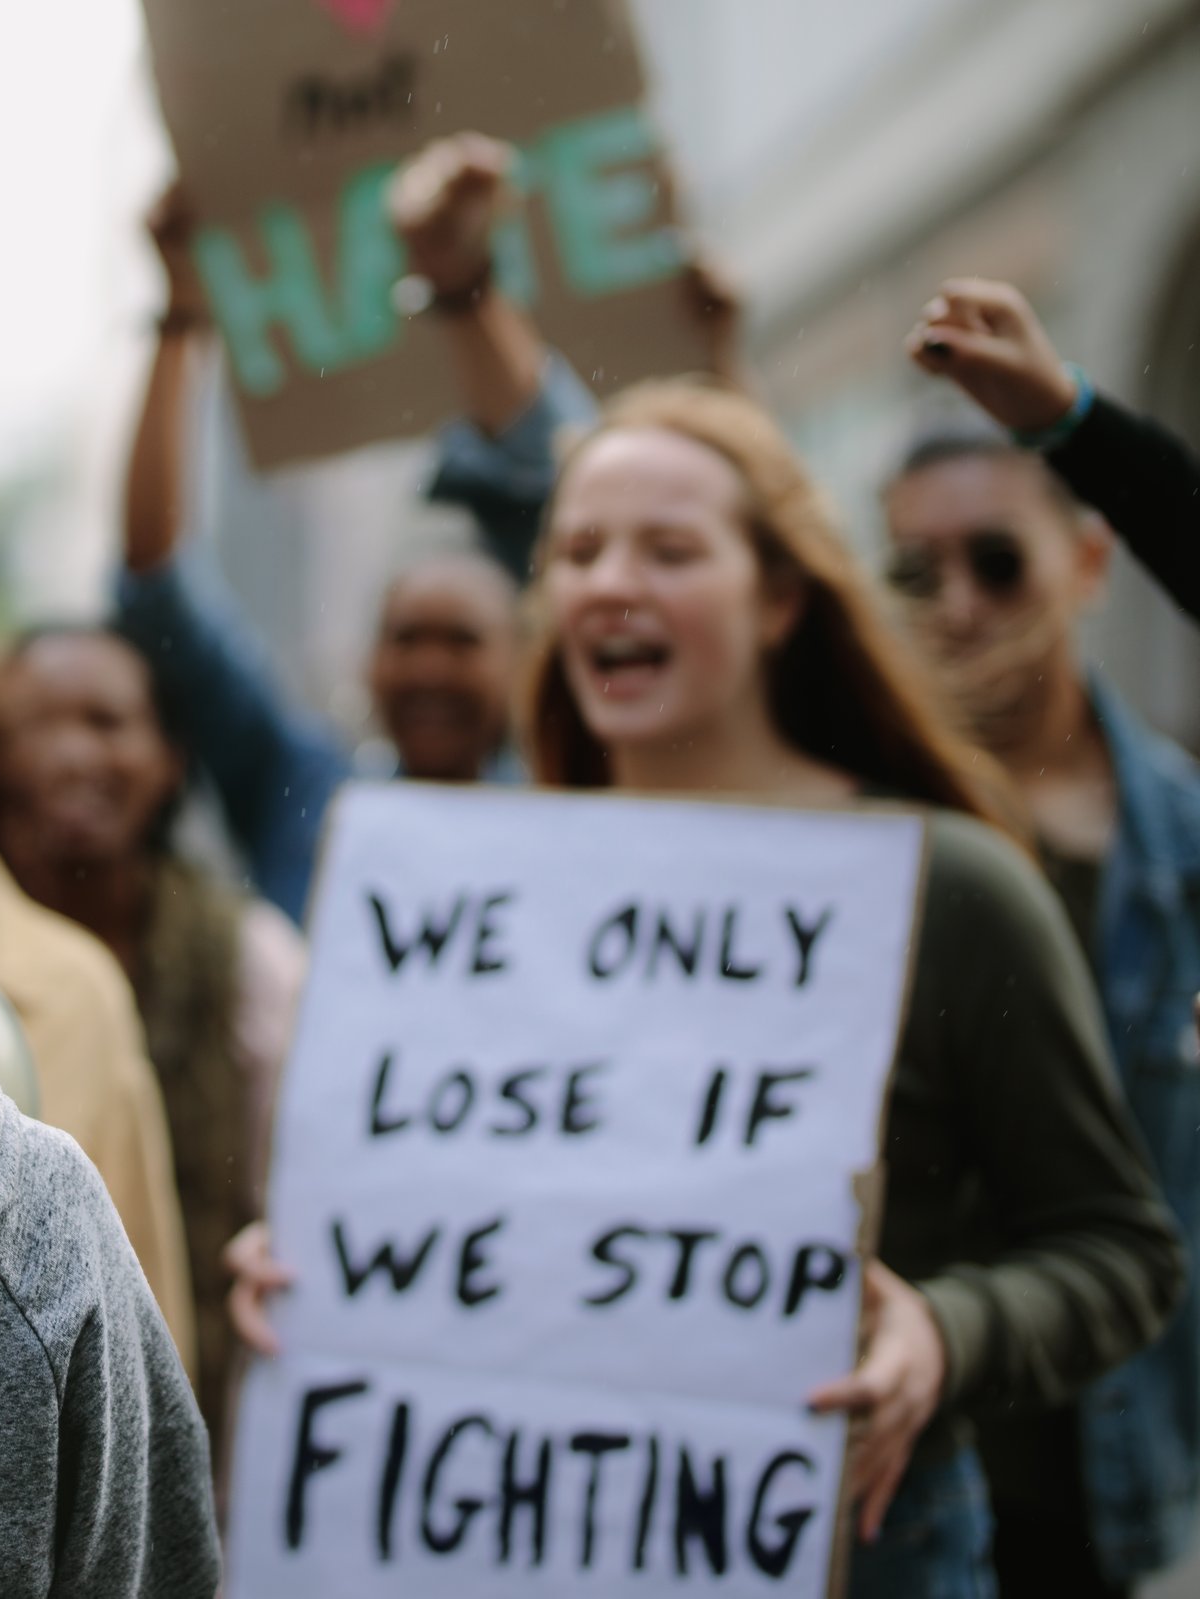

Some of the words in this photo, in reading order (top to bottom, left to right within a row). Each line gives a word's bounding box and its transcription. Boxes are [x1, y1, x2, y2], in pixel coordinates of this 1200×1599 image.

[367, 892, 511, 975] WE
[587, 901, 832, 988] ONLY
[368, 1052, 608, 1137] LOSE
[696, 1068, 814, 1147] IF
[331, 1216, 507, 1305] WE
[582, 1224, 850, 1318] STOP
[284, 1380, 816, 1579] FIGHTING
